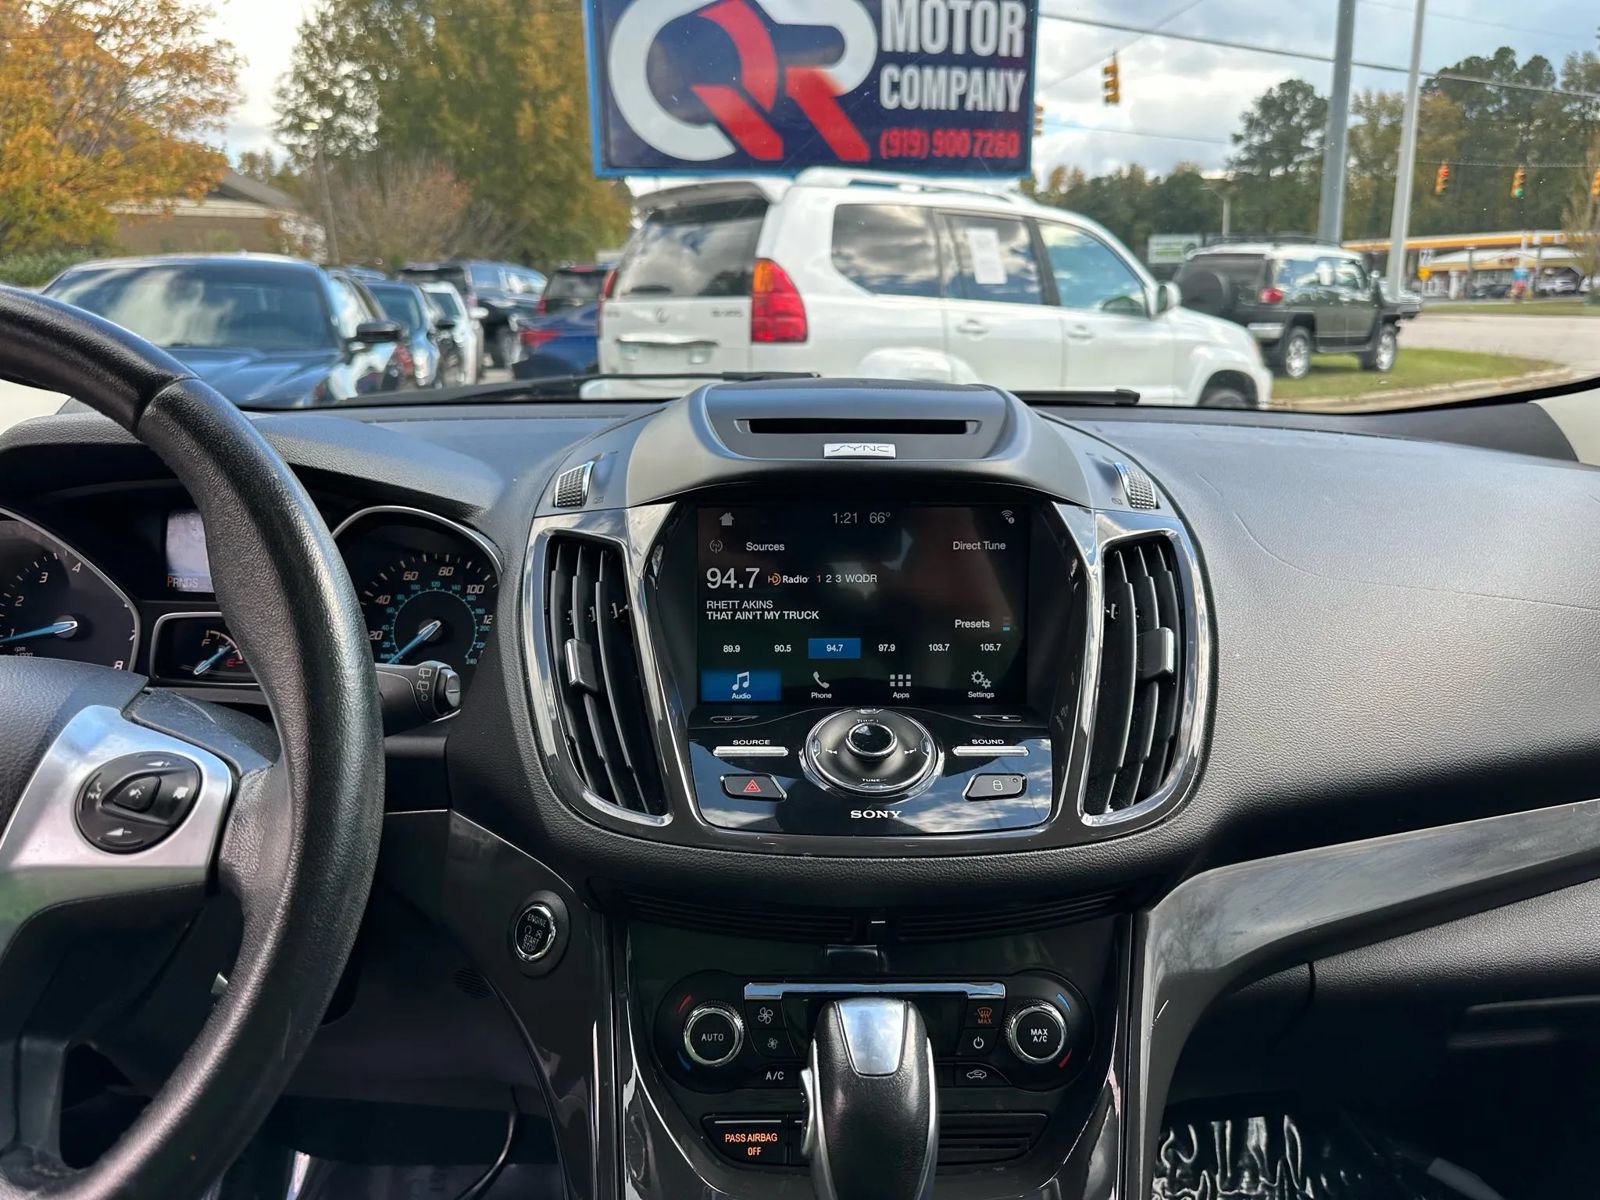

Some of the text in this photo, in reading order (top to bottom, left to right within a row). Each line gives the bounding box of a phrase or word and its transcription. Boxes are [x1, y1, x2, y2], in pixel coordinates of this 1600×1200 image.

[880, 0, 1026, 57] MOTOR
[879, 63, 1027, 112] COMPANY
[879, 128, 929, 159] (919)
[932, 128, 970, 159] 900
[830, 445, 889, 453] SYNC
[832, 512, 858, 525] 1:21
[745, 541, 785, 551] Sources
[952, 540, 1006, 551] Direct Tune
[72, 562, 82, 573] 4
[438, 567, 454, 577] 80
[39, 572, 48, 583] 3
[403, 571, 419, 581] 60
[706, 567, 760, 589] 94.7
[782, 574, 808, 584] Radio
[825, 574, 832, 584] 2
[835, 574, 842, 584] 3
[845, 574, 878, 584] WQDR
[467, 584, 485, 594] 100
[15, 596, 24, 606] 2
[376, 595, 391, 605] 40
[706, 600, 773, 610] RHETT AKINS
[706, 611, 819, 620] THAT AIN'T MY TRUCK
[954, 619, 990, 629] Presets
[368, 631, 383, 640] 20
[723, 644, 741, 653] 89.9
[774, 644, 792, 653] 90.5
[826, 644, 843, 652] 94.7
[878, 644, 896, 652] 97.9
[928, 643, 950, 652] 103.7
[980, 643, 1002, 652] 105.7
[731, 691, 752, 700] Audio
[811, 691, 832, 699] Phone
[892, 691, 910, 700] Apps
[968, 691, 994, 700] Settings
[972, 738, 1004, 746] SOUND
[850, 810, 902, 820] SONY
[1030, 1028, 1048, 1036] MAX
[701, 1033, 724, 1041] AUTO
[766, 1071, 785, 1080] A/C
[725, 1132, 778, 1142] PASS AIRBAG
[747, 1147, 761, 1156] OFF
